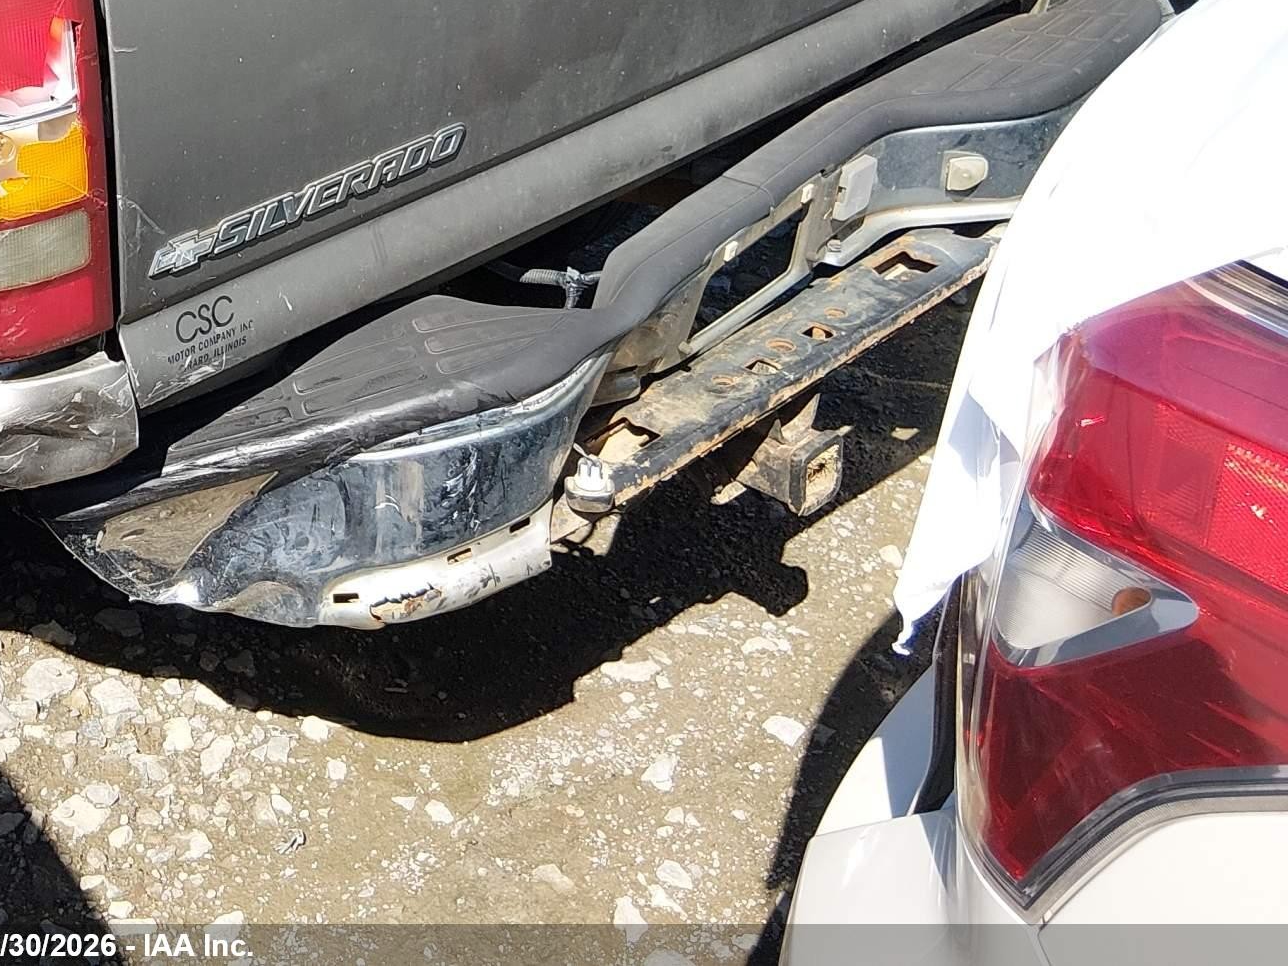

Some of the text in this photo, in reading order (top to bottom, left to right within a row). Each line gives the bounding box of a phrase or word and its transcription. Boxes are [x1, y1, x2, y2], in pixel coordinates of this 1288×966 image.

[212, 121, 468, 256] SILVERADO
[175, 295, 235, 344] CSC
[167, 344, 196, 365] MOTOR
[198, 327, 236, 352] COMPANY
[213, 335, 248, 358] ILLINOIS
